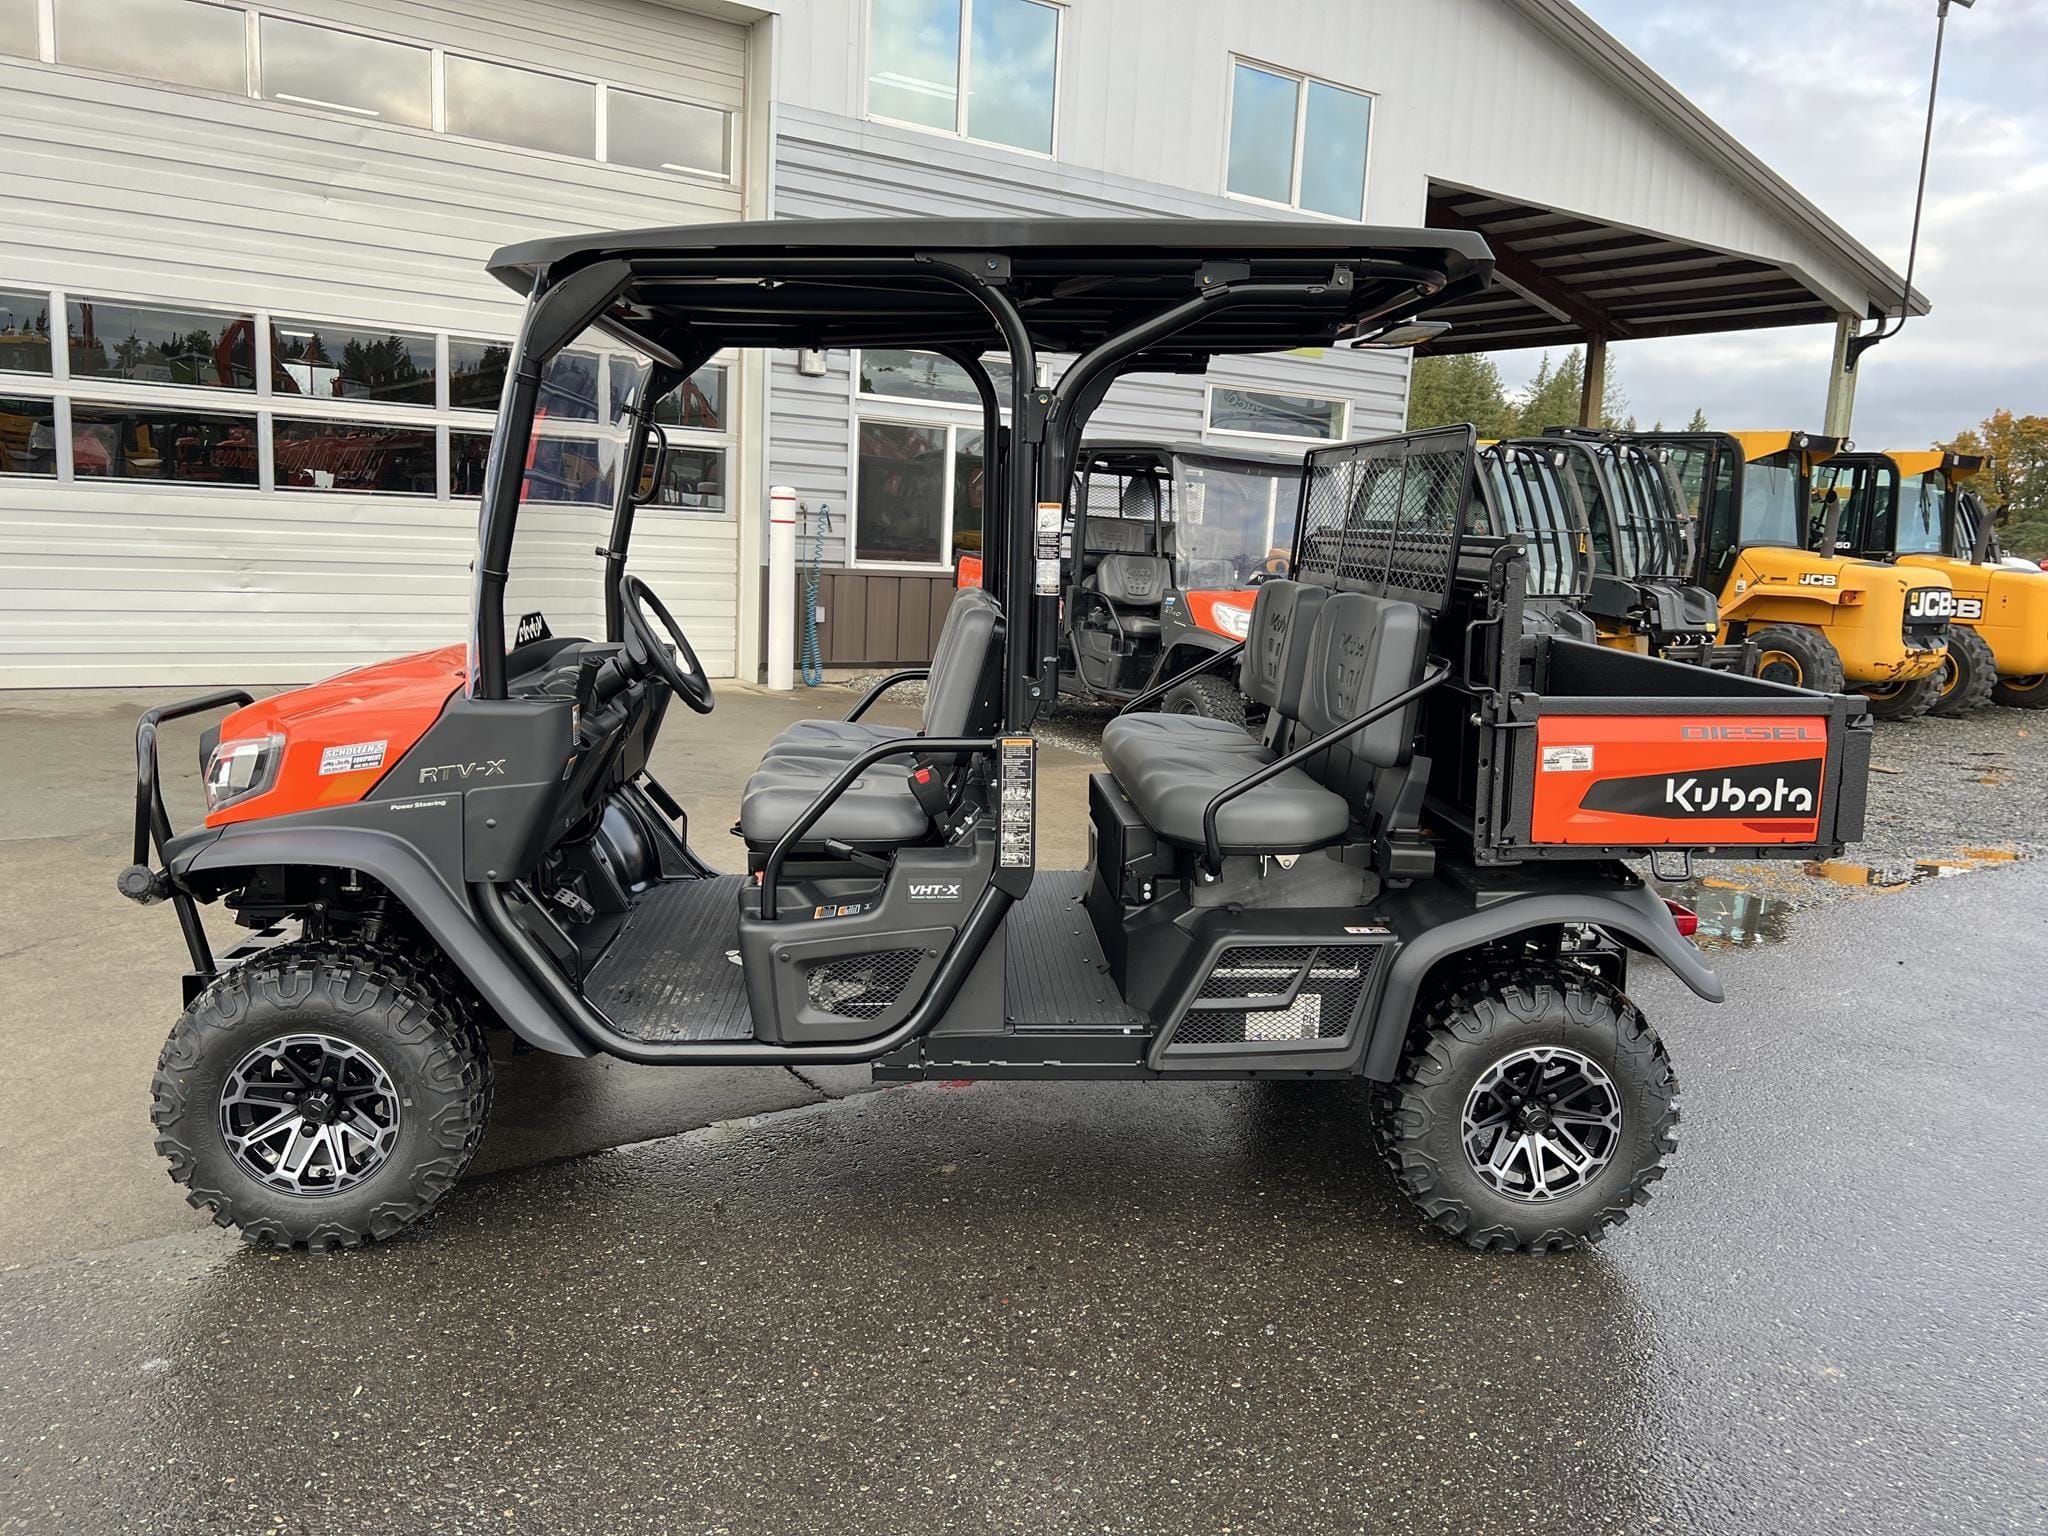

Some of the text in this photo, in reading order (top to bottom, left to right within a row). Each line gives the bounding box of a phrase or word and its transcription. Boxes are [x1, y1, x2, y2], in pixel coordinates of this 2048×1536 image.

[1799, 574, 1836, 586] JCB
[1910, 592, 1951, 617] JCB
[1681, 726, 1824, 741] DIESEL
[419, 759, 506, 784] RTV-X
[1665, 778, 1812, 812] Kubota
[414, 800, 446, 808] Steering
[909, 885, 960, 895] VHT-X
